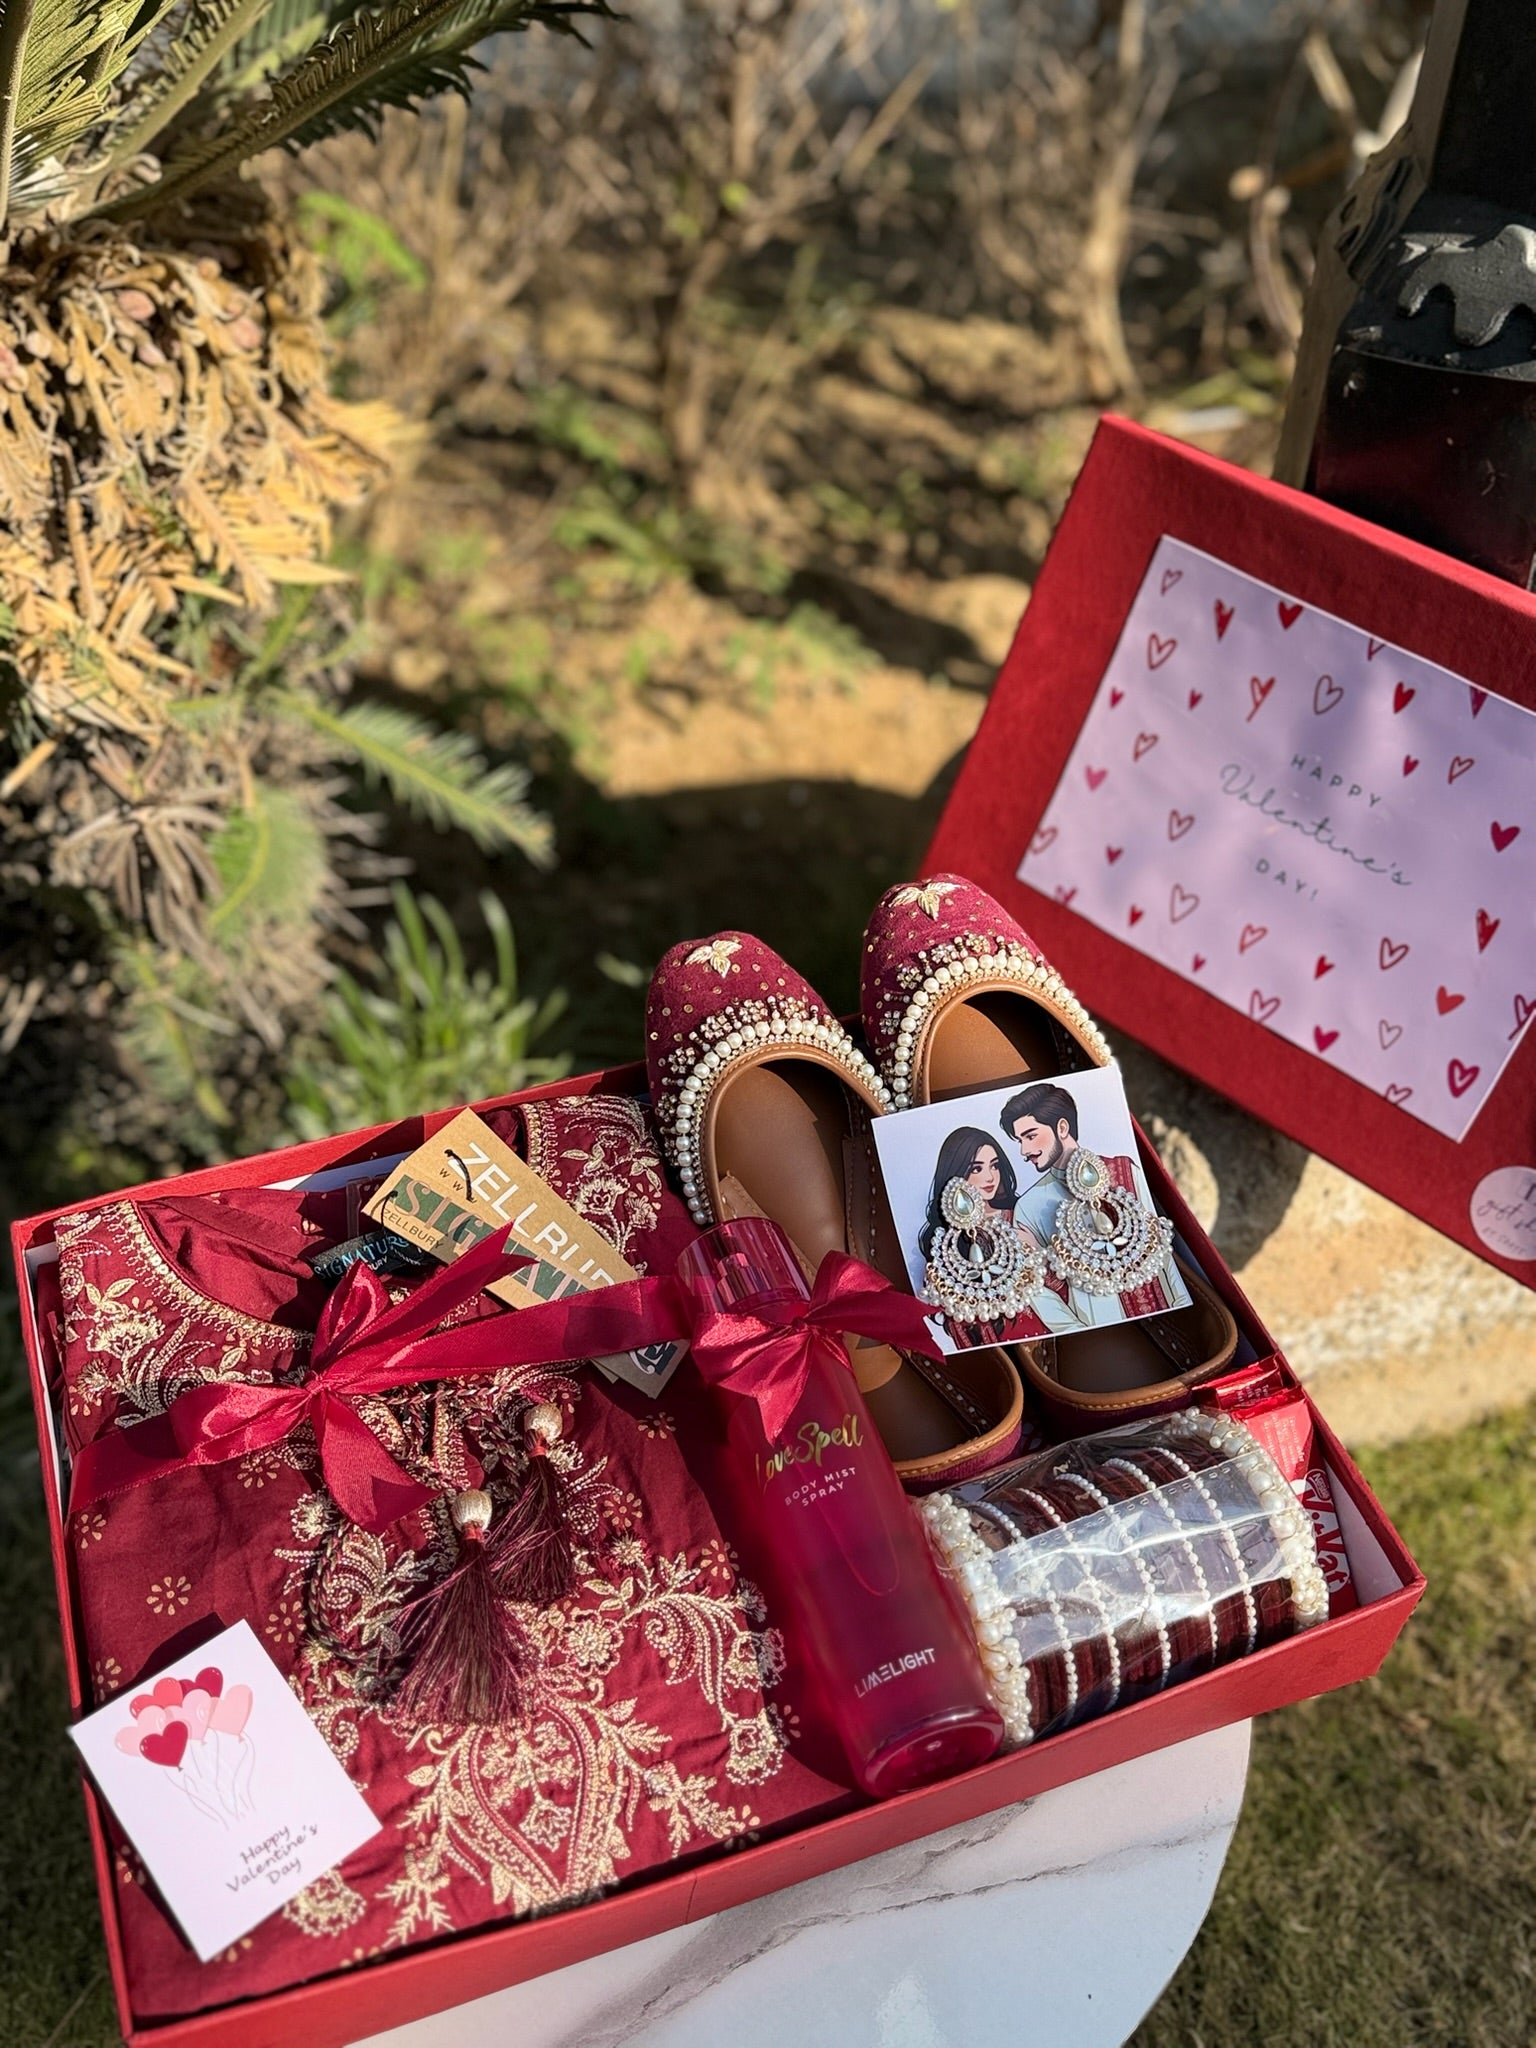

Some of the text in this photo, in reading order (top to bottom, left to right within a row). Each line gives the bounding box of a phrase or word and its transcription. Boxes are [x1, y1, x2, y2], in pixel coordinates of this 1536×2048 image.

[1291, 754, 1381, 808] HAPPY
[1255, 858, 1319, 901] DAY!
[382, 1208, 444, 1249] ZELLBURY
[784, 1466, 856, 1507] BODY MIST
[801, 1481, 844, 1507] SPRAY
[854, 1647, 936, 1699] LIMELIGHT
[225, 1823, 319, 1892] Valentine's
[239, 1825, 290, 1865] Happy
[265, 1857, 302, 1886] Day
